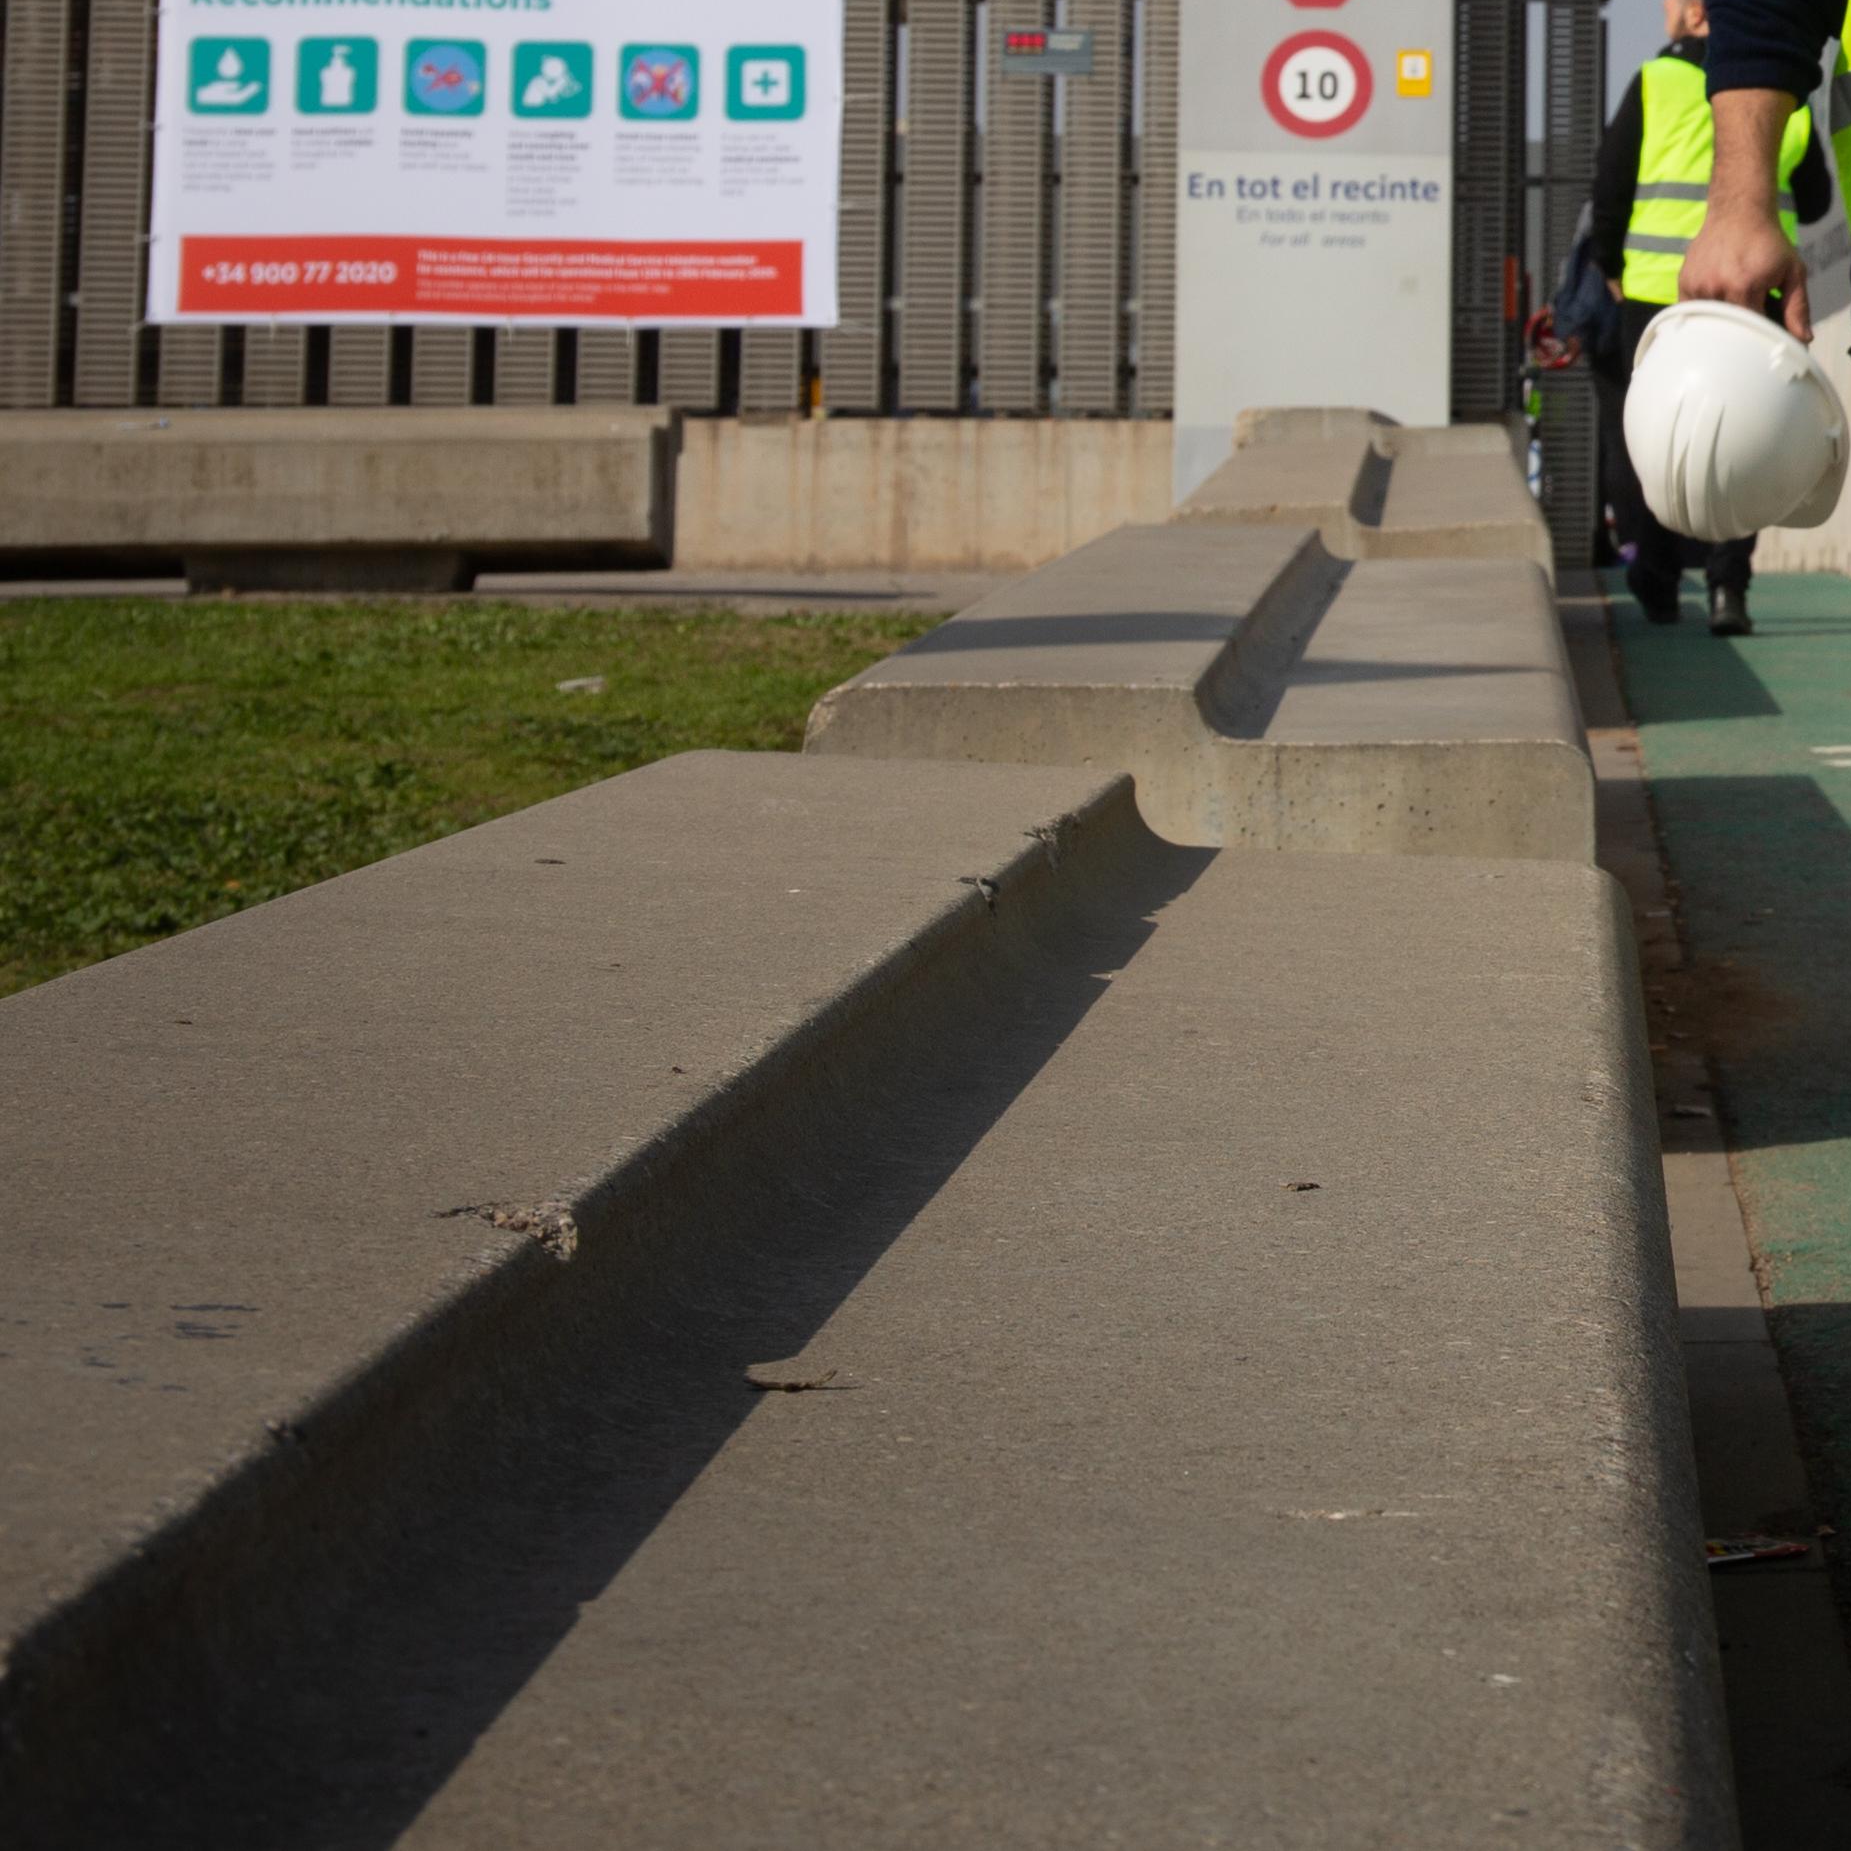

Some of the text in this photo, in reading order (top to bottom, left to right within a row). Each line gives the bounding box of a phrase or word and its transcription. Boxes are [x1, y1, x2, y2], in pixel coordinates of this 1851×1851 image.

[1294, 70, 1340, 101] 10
[1186, 171, 1441, 202] En tot el recinte
[201, 260, 247, 285] +34
[250, 260, 300, 285] 900
[302, 260, 333, 285] 77
[335, 260, 398, 285] 2020
